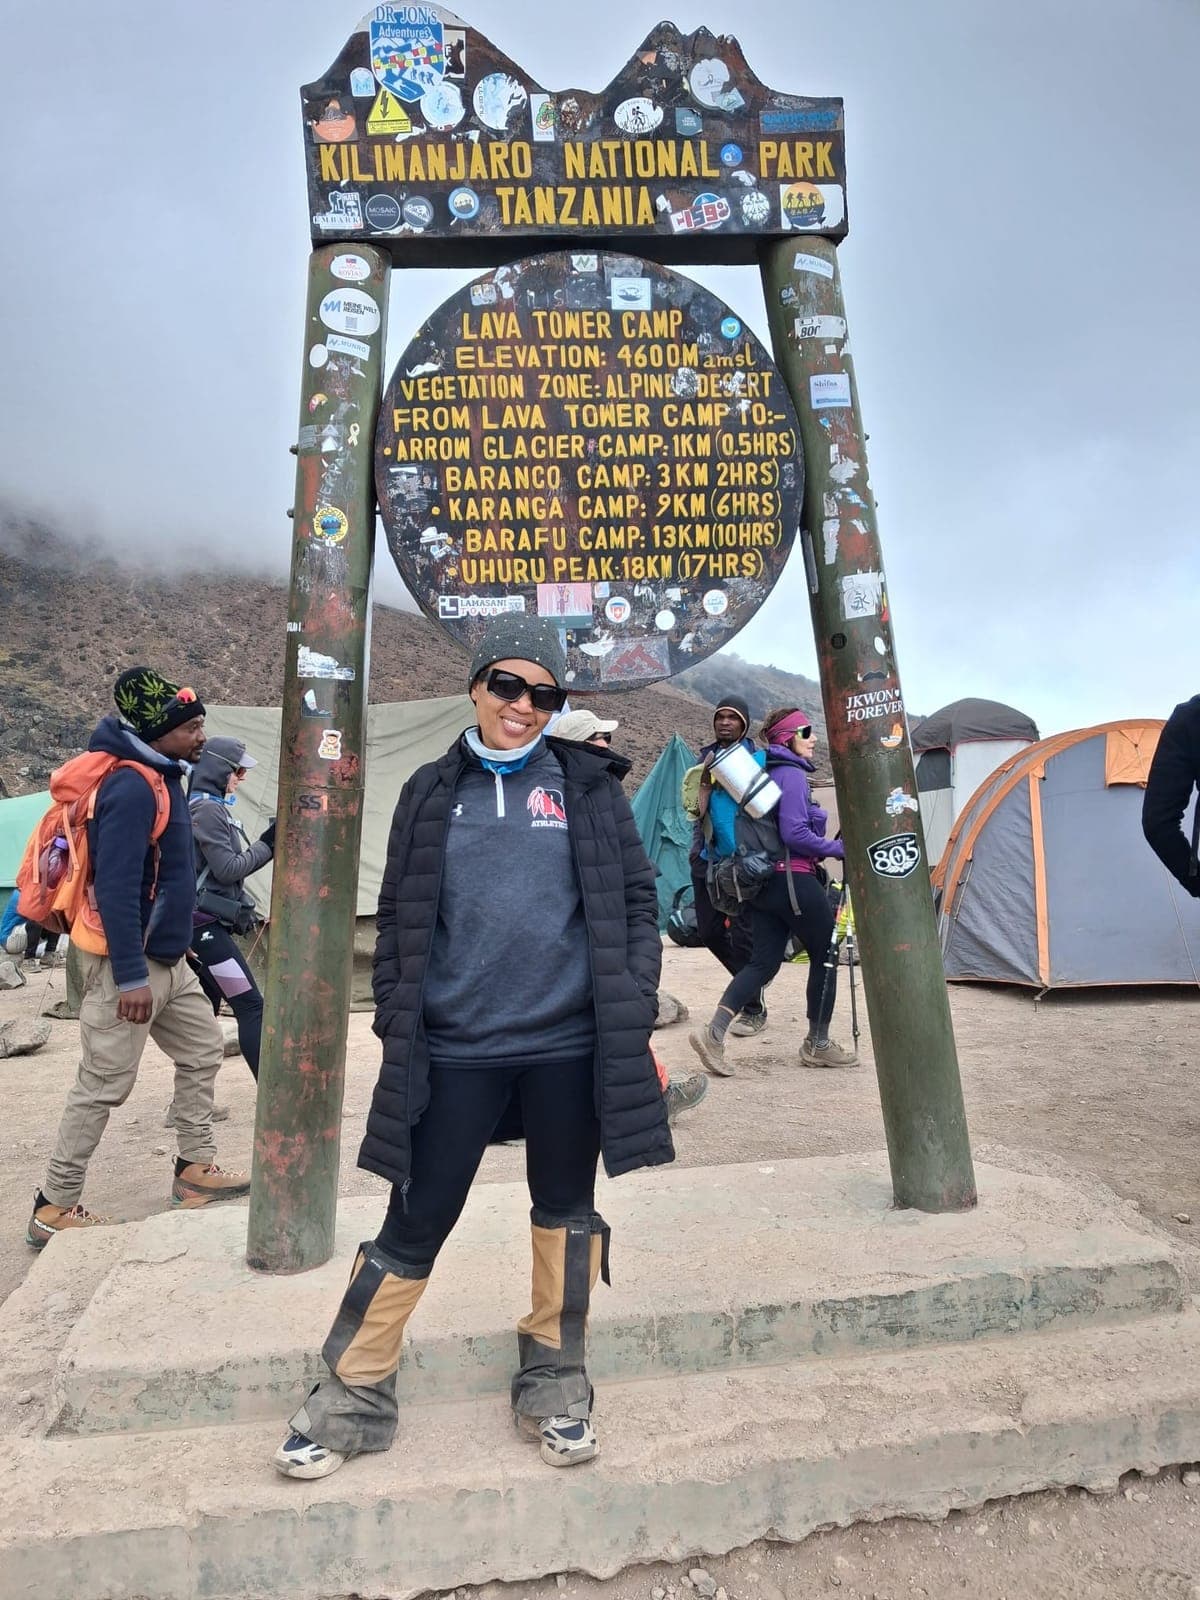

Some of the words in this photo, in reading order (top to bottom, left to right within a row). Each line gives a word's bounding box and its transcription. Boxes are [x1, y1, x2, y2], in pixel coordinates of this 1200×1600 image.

[375, 5, 394, 23] DR
[379, 25, 430, 40] Adventures
[319, 141, 533, 182] KILIMANJARO
[564, 139, 721, 180] NATIONAL
[759, 140, 835, 178] PARK
[495, 185, 655, 226] TANZANIA
[462, 311, 522, 342] LAVA
[533, 310, 612, 340] TOWER
[621, 309, 683, 339] CAMP
[455, 344, 607, 370] ELEVATION:
[616, 343, 699, 369] 4600M
[705, 342, 756, 369] amsl
[400, 373, 525, 401] VEGETATION
[538, 373, 600, 400] ZONE:
[604, 372, 672, 400] ALPINE
[392, 404, 472, 432] FROM
[480, 403, 547, 430] LAVA
[563, 402, 651, 429] TOWER
[662, 402, 727, 428] CAMP
[396, 436, 471, 461] ARROW
[482, 434, 585, 461] GLACIER
[597, 433, 667, 458] CAMP:
[672, 433, 711, 458] 1KM
[716, 428, 796, 460] (0.5HRS)
[576, 463, 651, 490] CAMP:
[716, 458, 780, 489] 2HRS)
[448, 495, 565, 522] KARANGA
[577, 494, 647, 520] CAMP:
[656, 492, 706, 518] 9KM
[710, 488, 782, 521] (6HRS)
[464, 526, 567, 554] BARAFU
[577, 525, 646, 551] CAMP:
[460, 557, 546, 586] UHURU
[677, 548, 764, 582] (17HRS)
[846, 688, 894, 709] JKWON
[847, 700, 904, 723] FOREVER
[874, 840, 919, 871] 805
